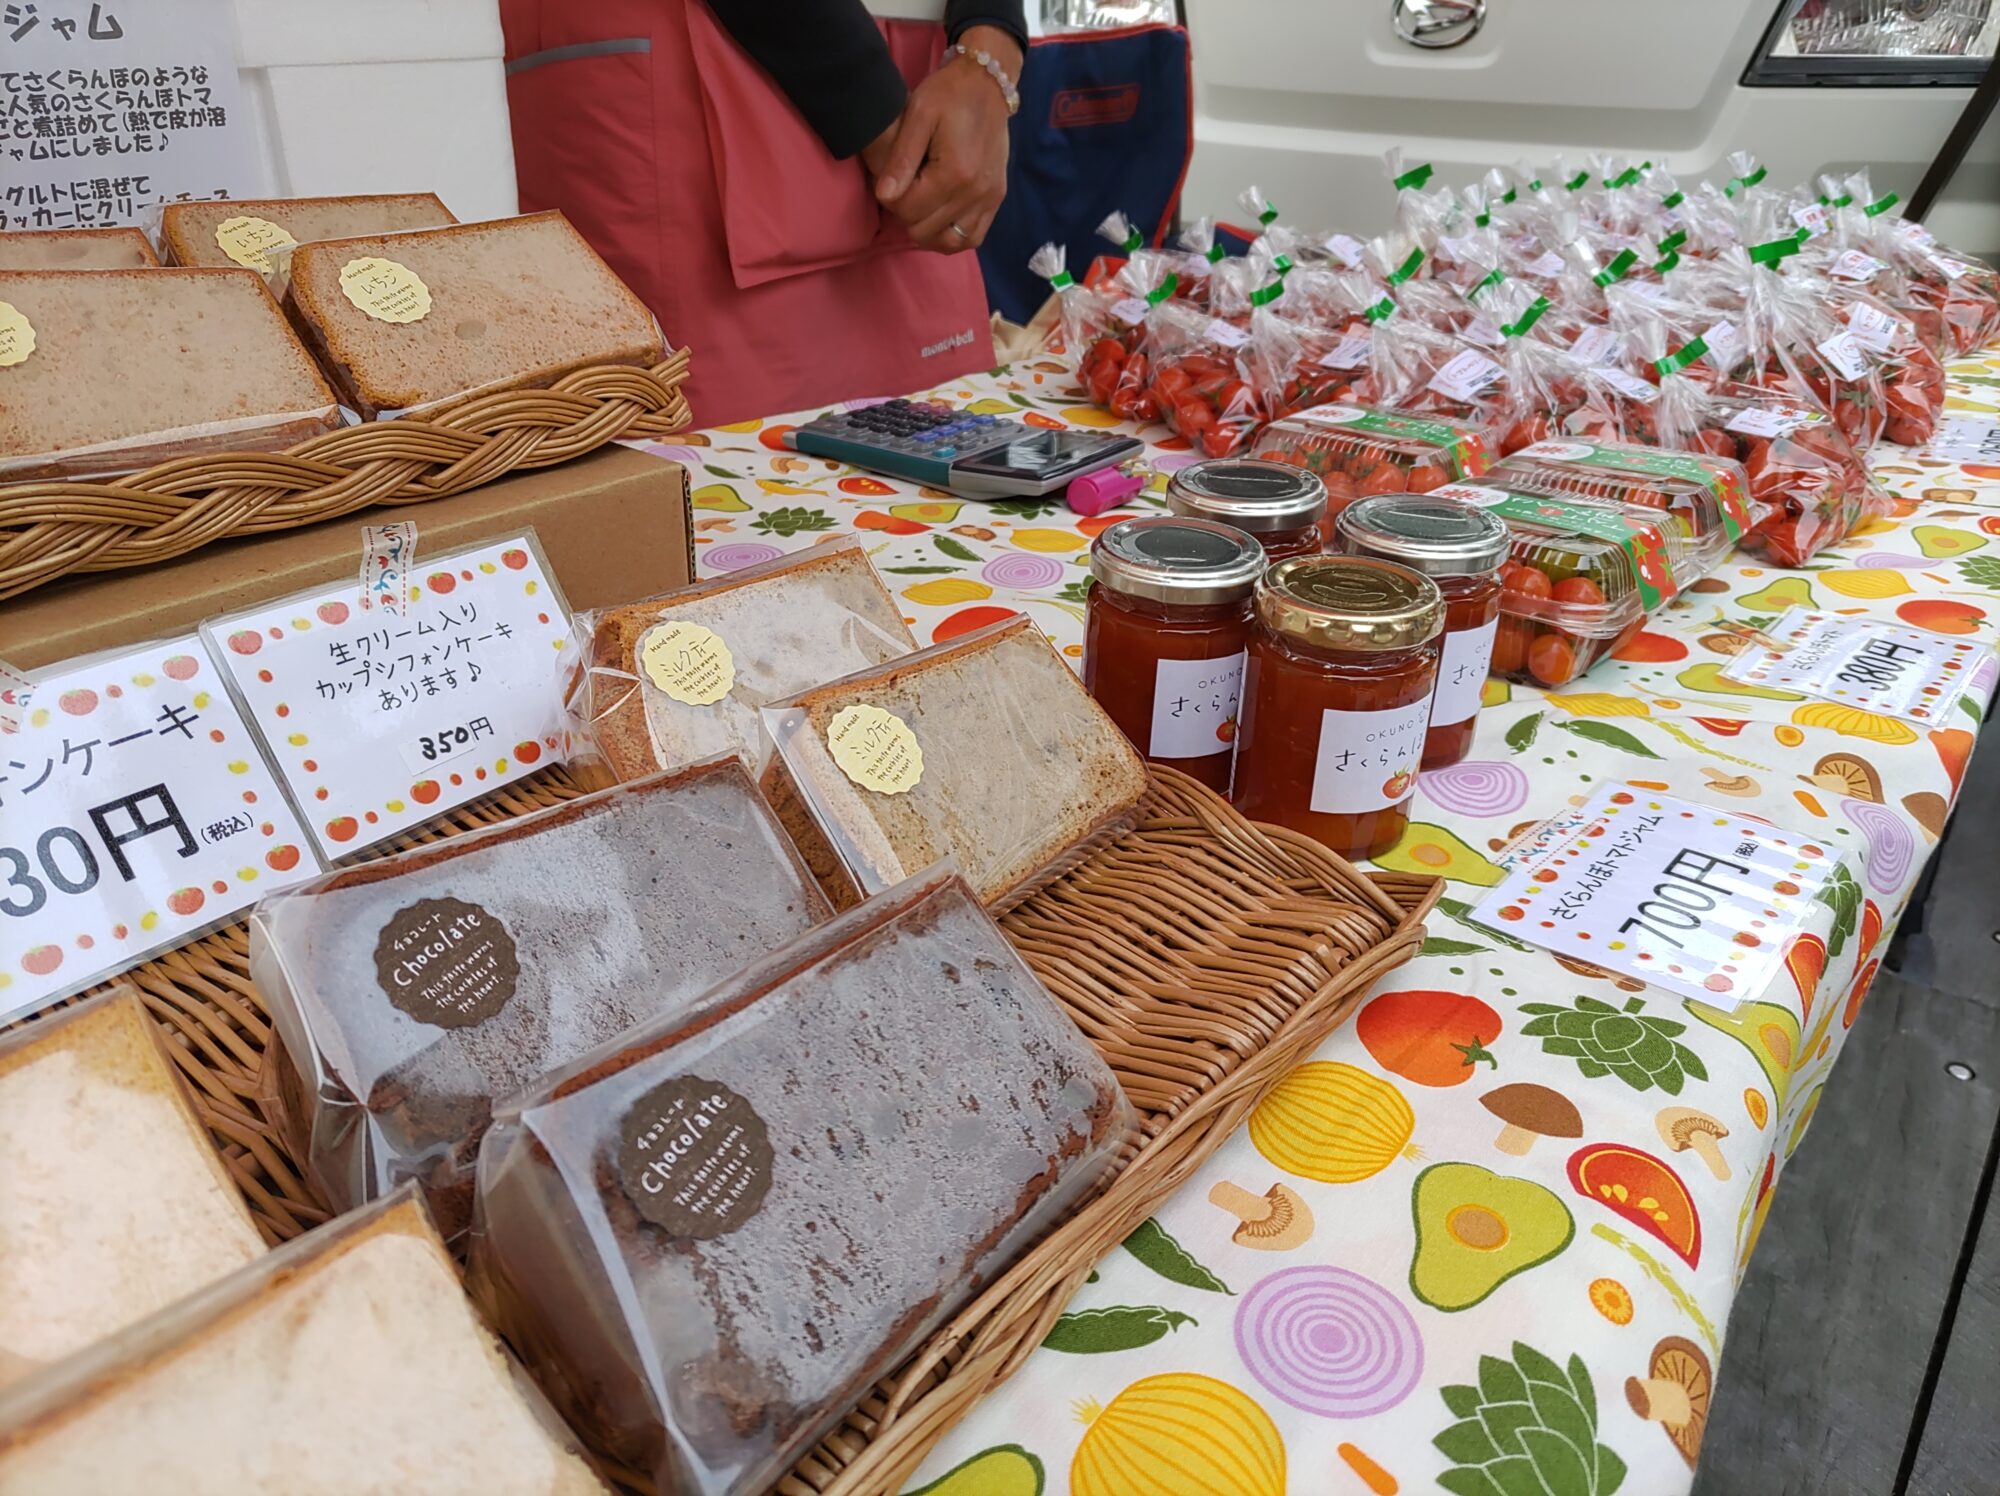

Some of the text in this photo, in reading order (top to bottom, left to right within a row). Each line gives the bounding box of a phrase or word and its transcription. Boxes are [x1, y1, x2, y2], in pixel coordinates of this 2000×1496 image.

[4, 3, 123, 42] ジャム
[0, 132, 168, 161] ャムにしました♪
[0, 176, 150, 206] グルトに混ぜて
[329, 601, 478, 666] 生クリーム入り
[315, 621, 513, 700] カップシフォンケーキ
[1836, 637, 1924, 691] 380円
[0, 704, 199, 800] ンケーキ
[418, 716, 495, 760] 350円
[1366, 720, 1414, 742] OKUNO
[200, 811, 254, 845] (税込)
[1548, 815, 1664, 920] さくらんぼトマトジャム
[1618, 848, 1751, 949] 700円
[393, 914, 480, 986] Chocolate
[420, 940, 494, 1000] This taste warms
[436, 956, 498, 1008] the cockles of
[458, 998, 476, 1013] the
[641, 1095, 728, 1193] Chocolate
[739, 1143, 752, 1158] of
[672, 1183, 698, 1206] This
[713, 1198, 735, 1217] the
